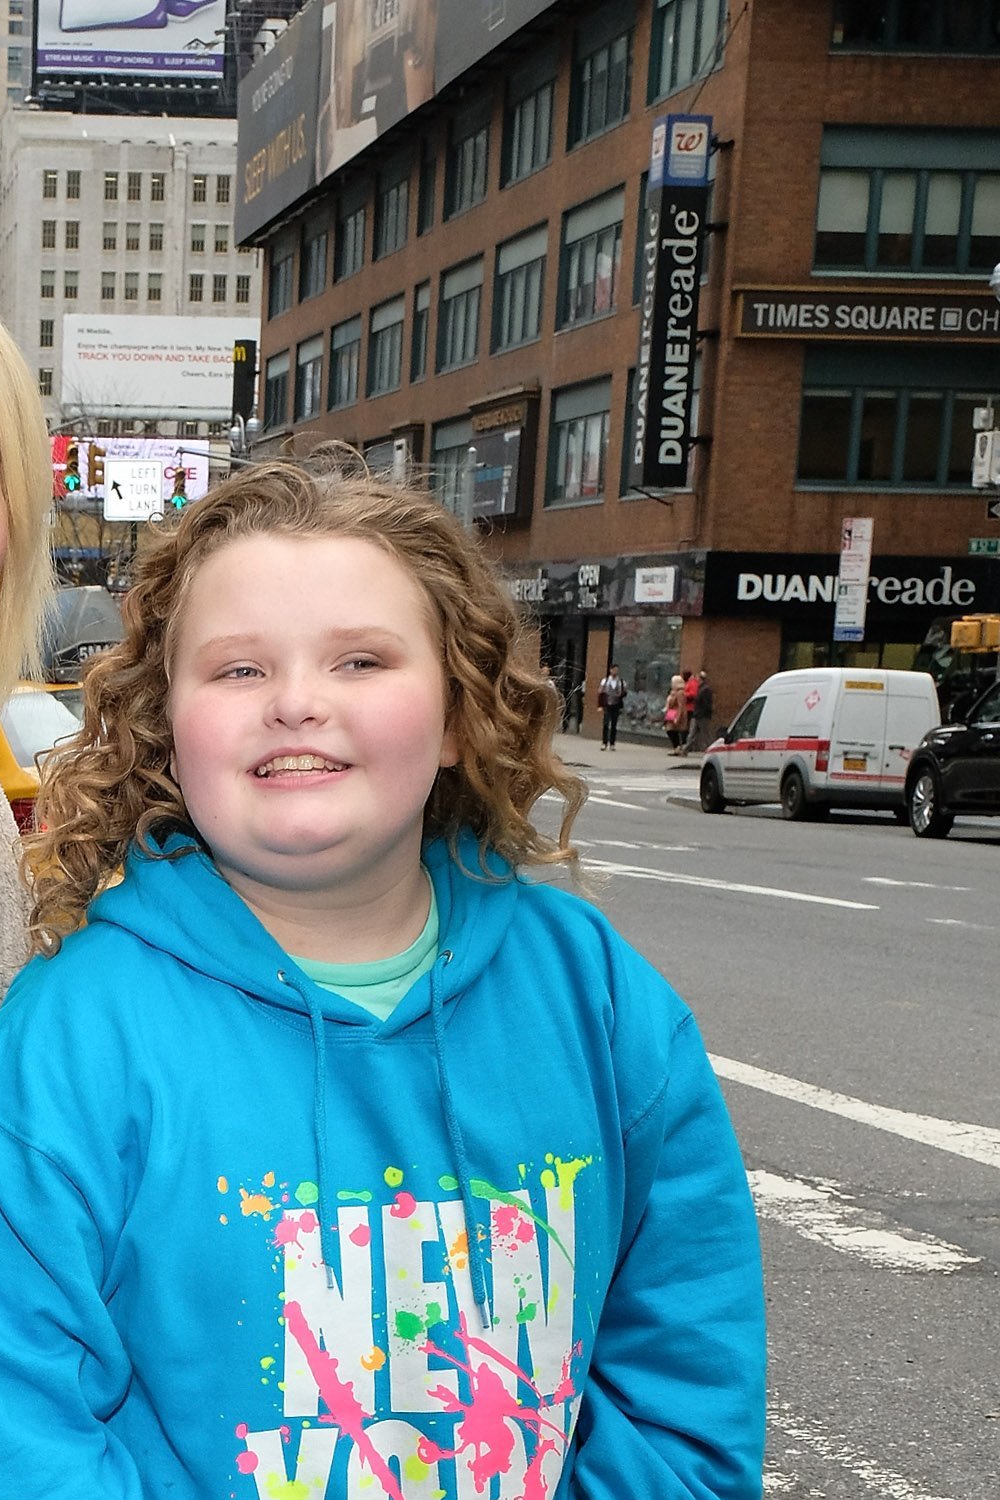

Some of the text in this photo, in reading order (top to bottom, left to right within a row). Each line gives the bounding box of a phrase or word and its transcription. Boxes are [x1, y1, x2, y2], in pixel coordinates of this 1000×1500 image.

[73, 55, 94, 63] MUSIC
[104, 55, 122, 63] STOP
[753, 303, 1000, 331] TIMES SQUARE CH
[77, 342, 95, 350] Enjoy
[196, 345, 206, 354] My
[78, 352, 234, 363] TRACK YOU DOWN AND TAKE BAC
[182, 370, 206, 378] Cheers,
[131, 468, 156, 479] LEFT
[130, 484, 157, 495] TURN
[129, 501, 157, 511] LANE
[283, 1187, 576, 1417] NEW
